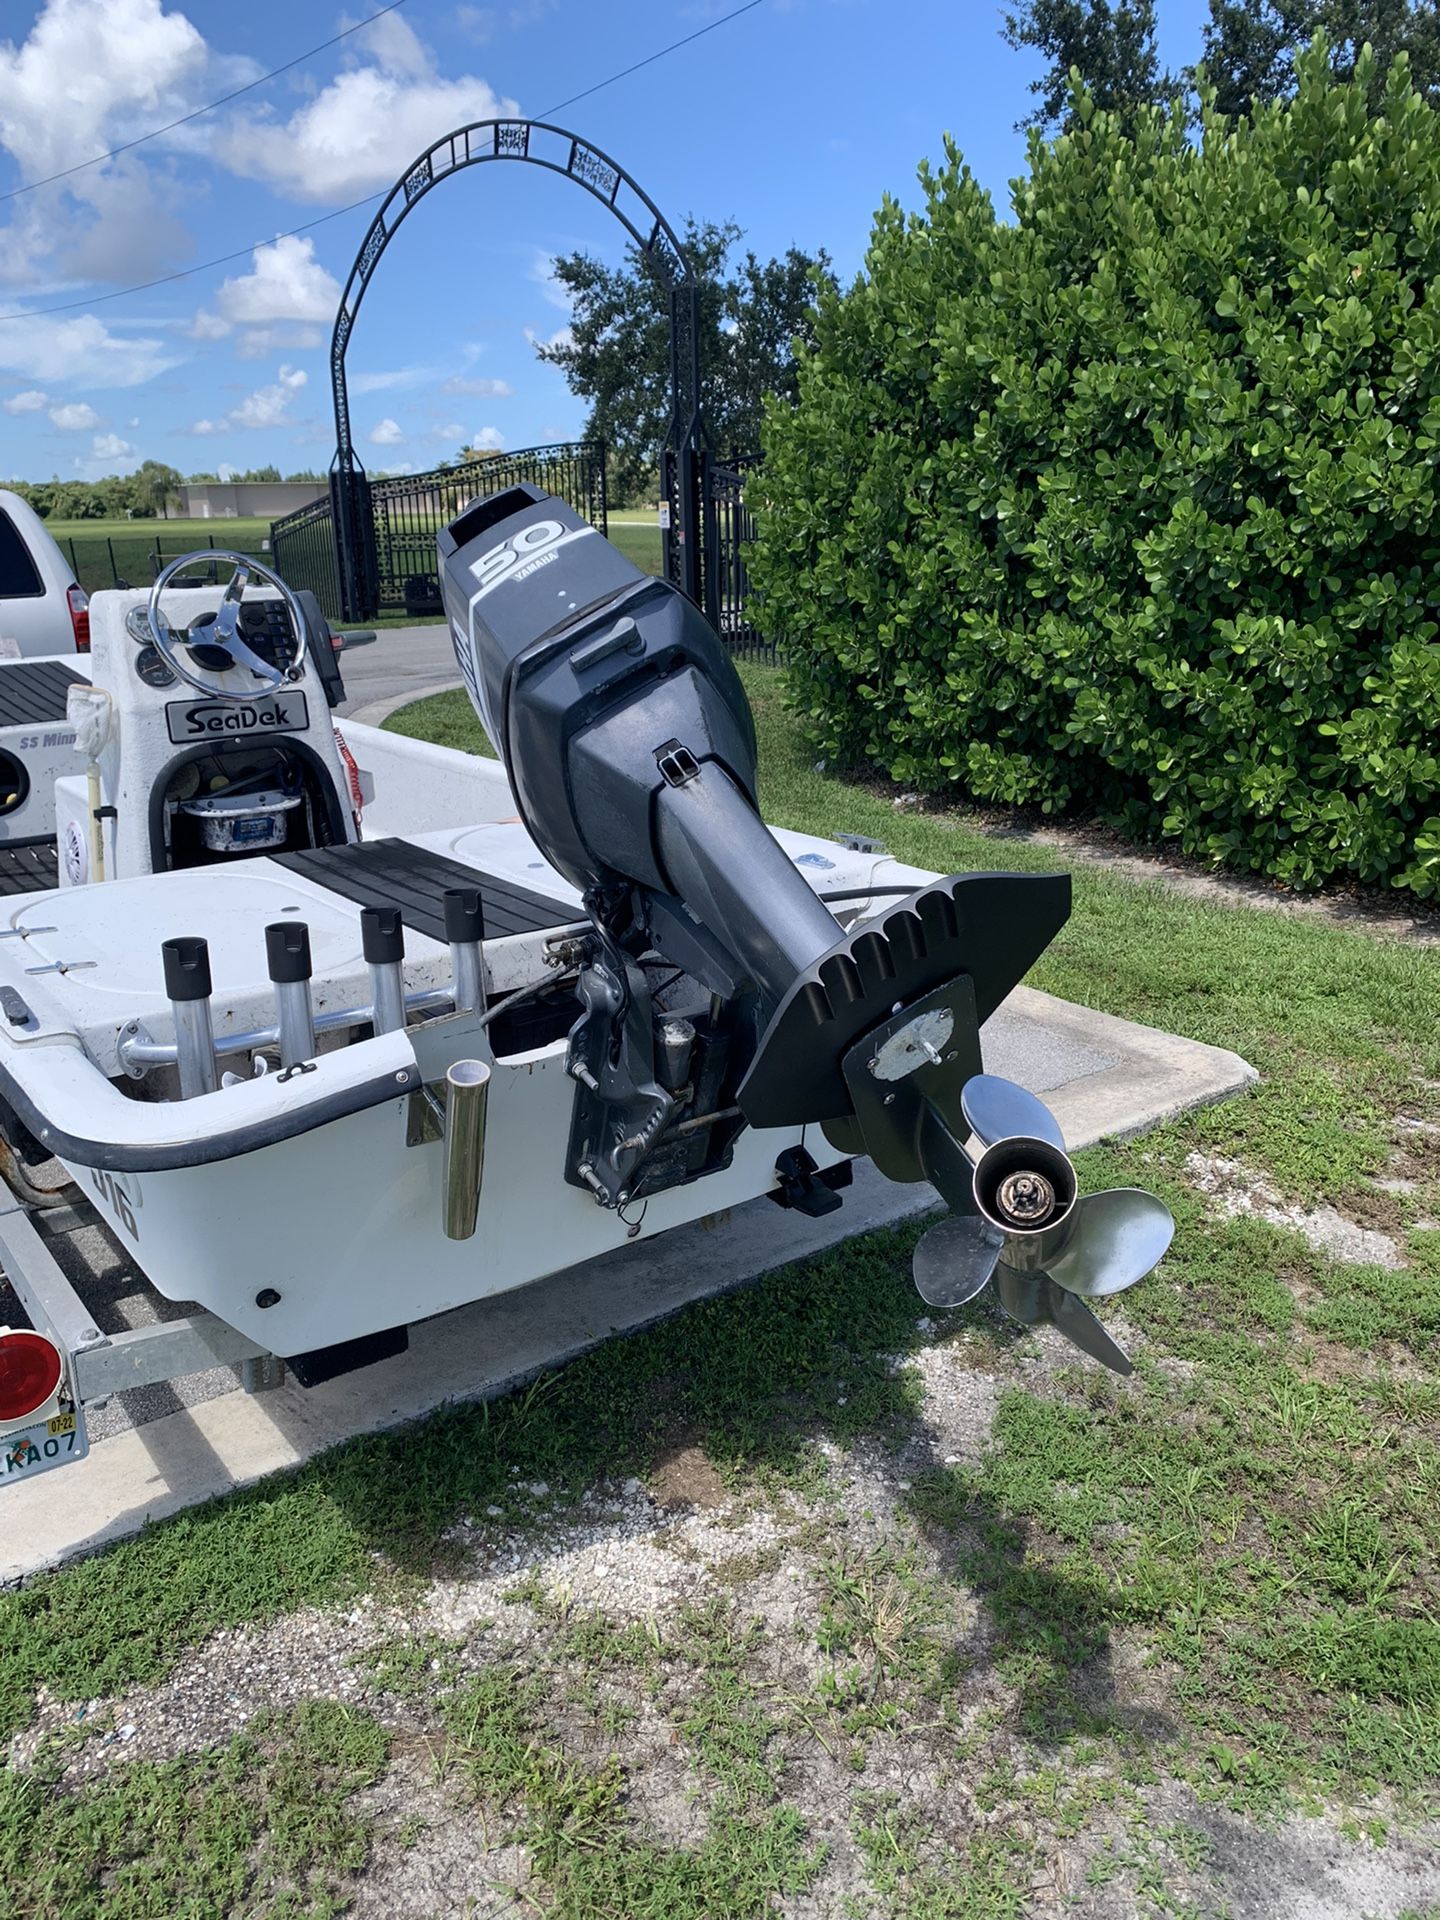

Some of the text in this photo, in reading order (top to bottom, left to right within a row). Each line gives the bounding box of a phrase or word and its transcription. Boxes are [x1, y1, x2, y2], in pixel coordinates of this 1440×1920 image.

[469, 520, 565, 586] 50
[514, 551, 558, 580] YAMAHA
[185, 704, 290, 734] SeaDek
[20, 732, 77, 750] SS Minn
[51, 1416, 73, 1433] 07-22
[0, 1430, 76, 1475] KA07
